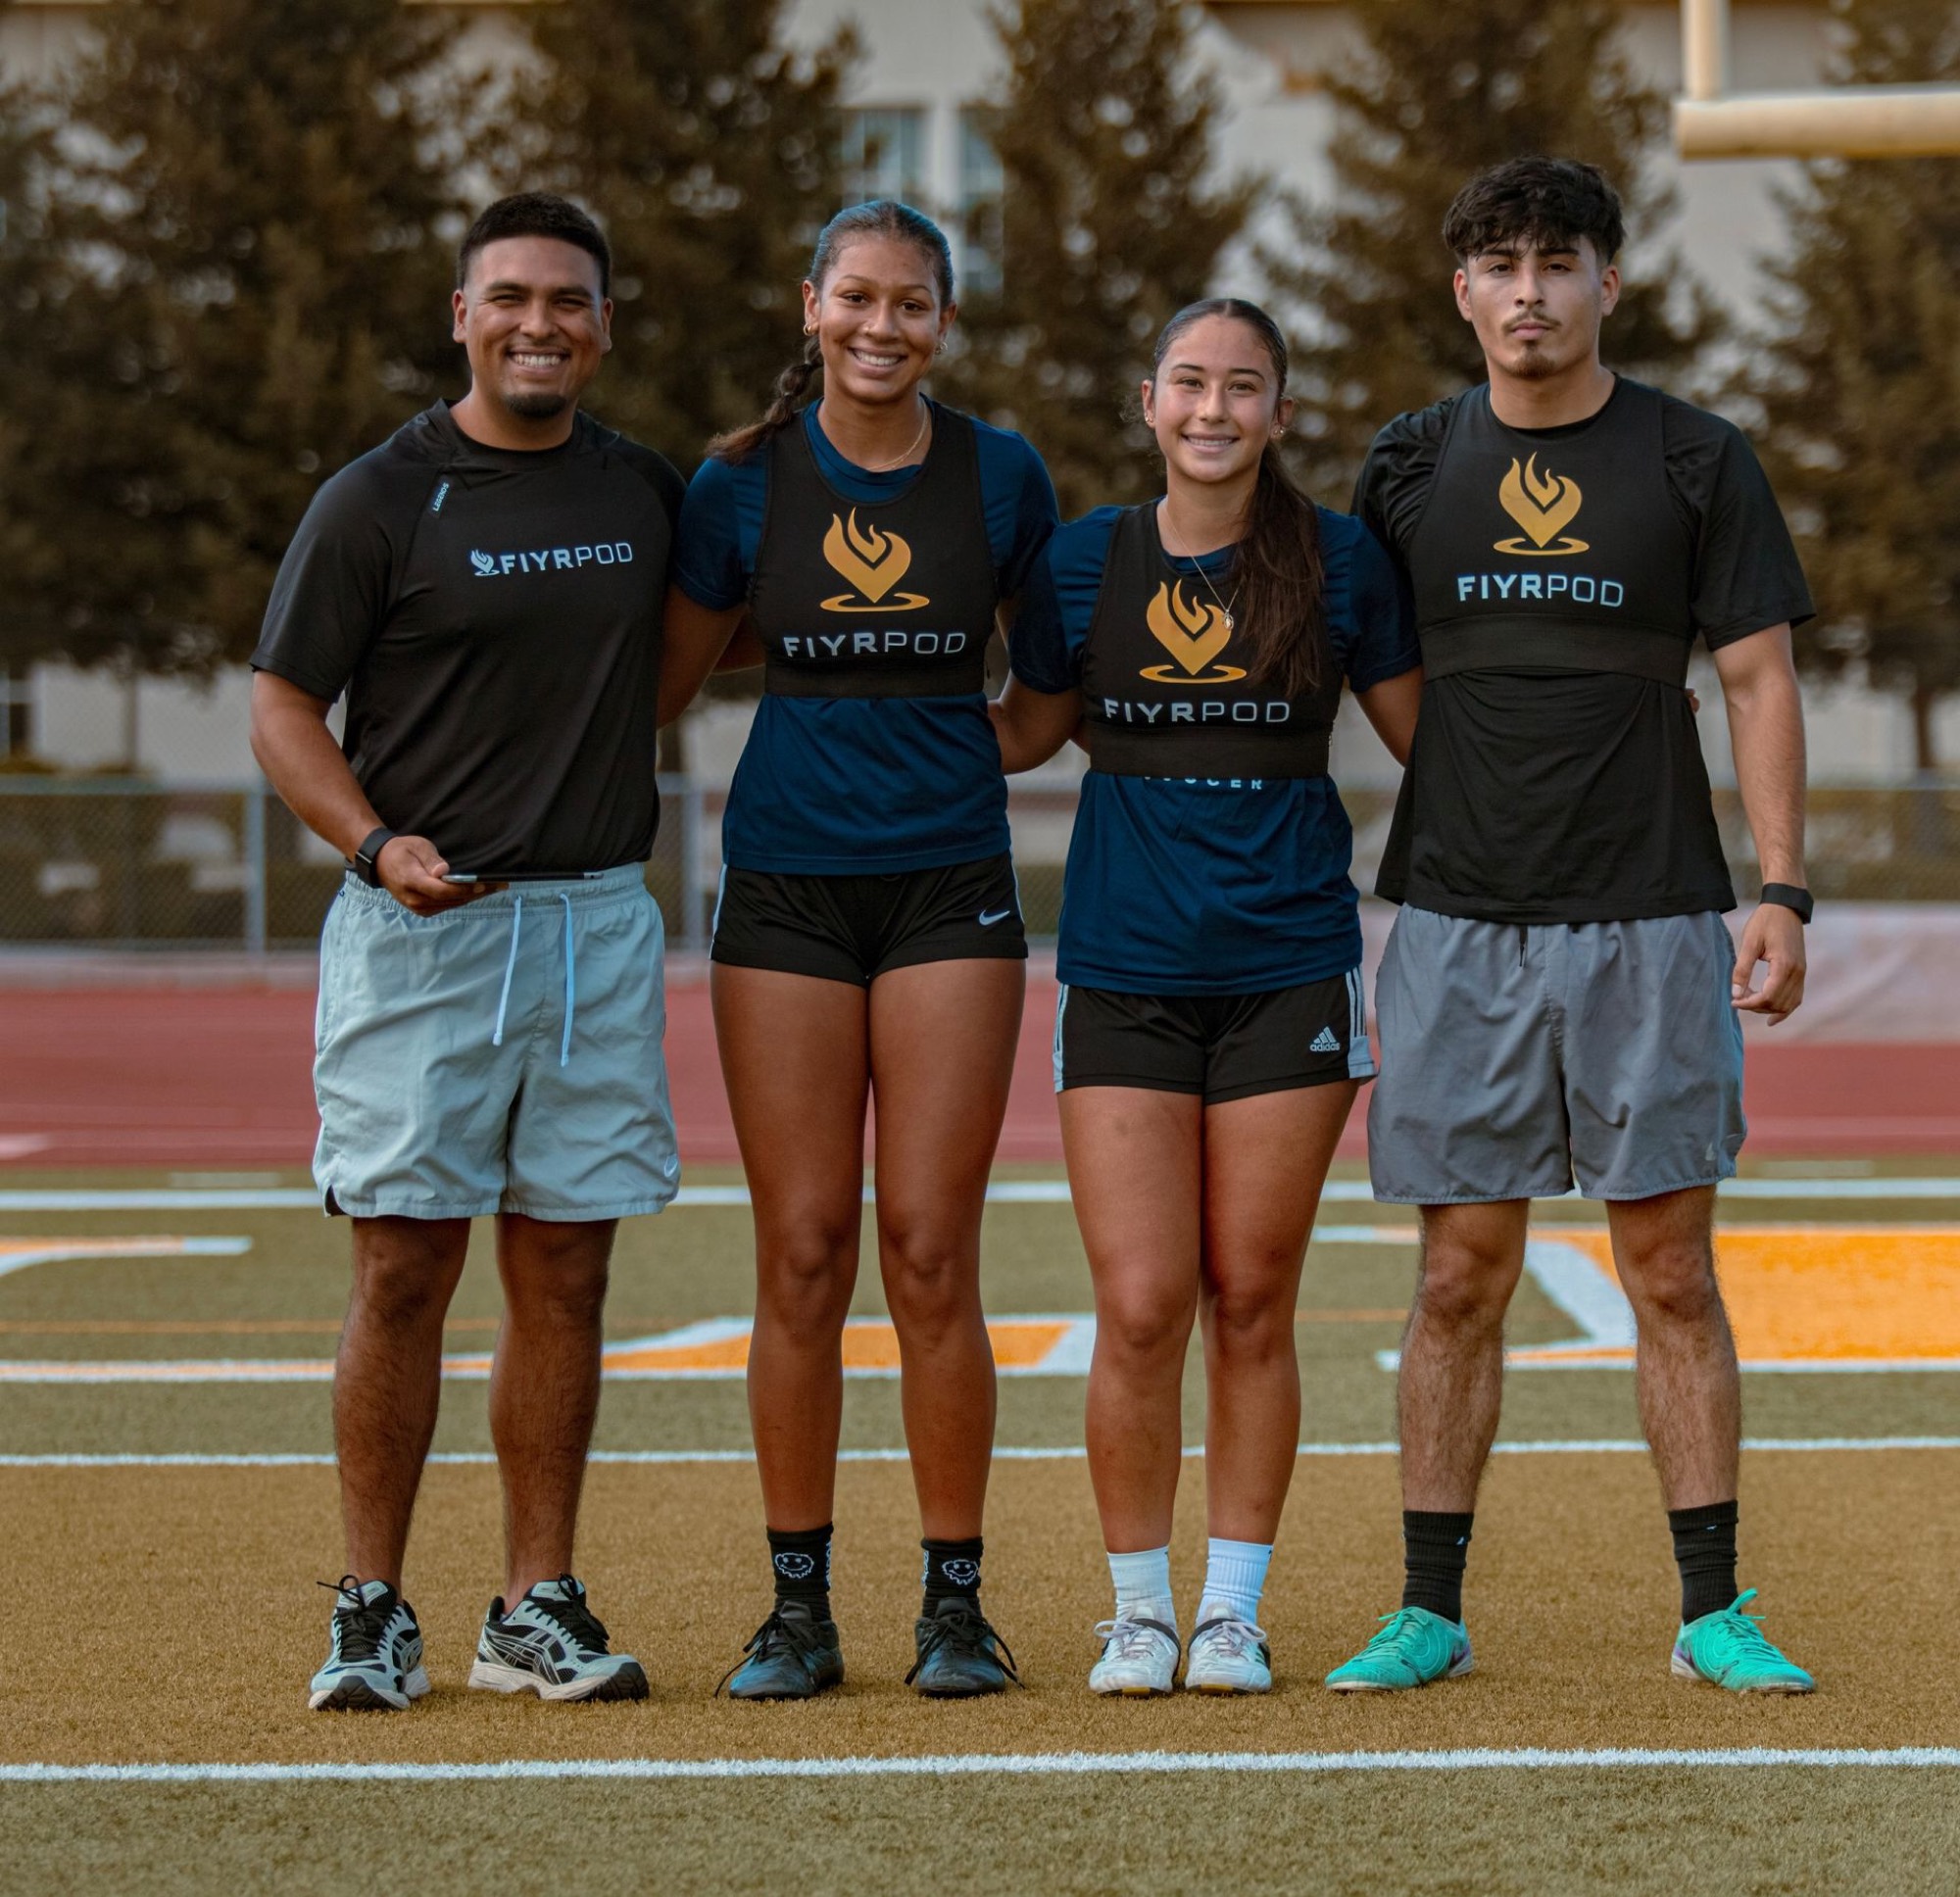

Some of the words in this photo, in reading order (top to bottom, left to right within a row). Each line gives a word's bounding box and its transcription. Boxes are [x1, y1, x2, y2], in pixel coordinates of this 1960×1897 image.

[499, 542, 633, 575] FIYRPOD
[1457, 574, 1624, 608] FIYRPOD
[783, 631, 966, 658] FIYRPOD
[1103, 697, 1291, 723] FIYRPOD
[1309, 1042, 1341, 1052] adidas
